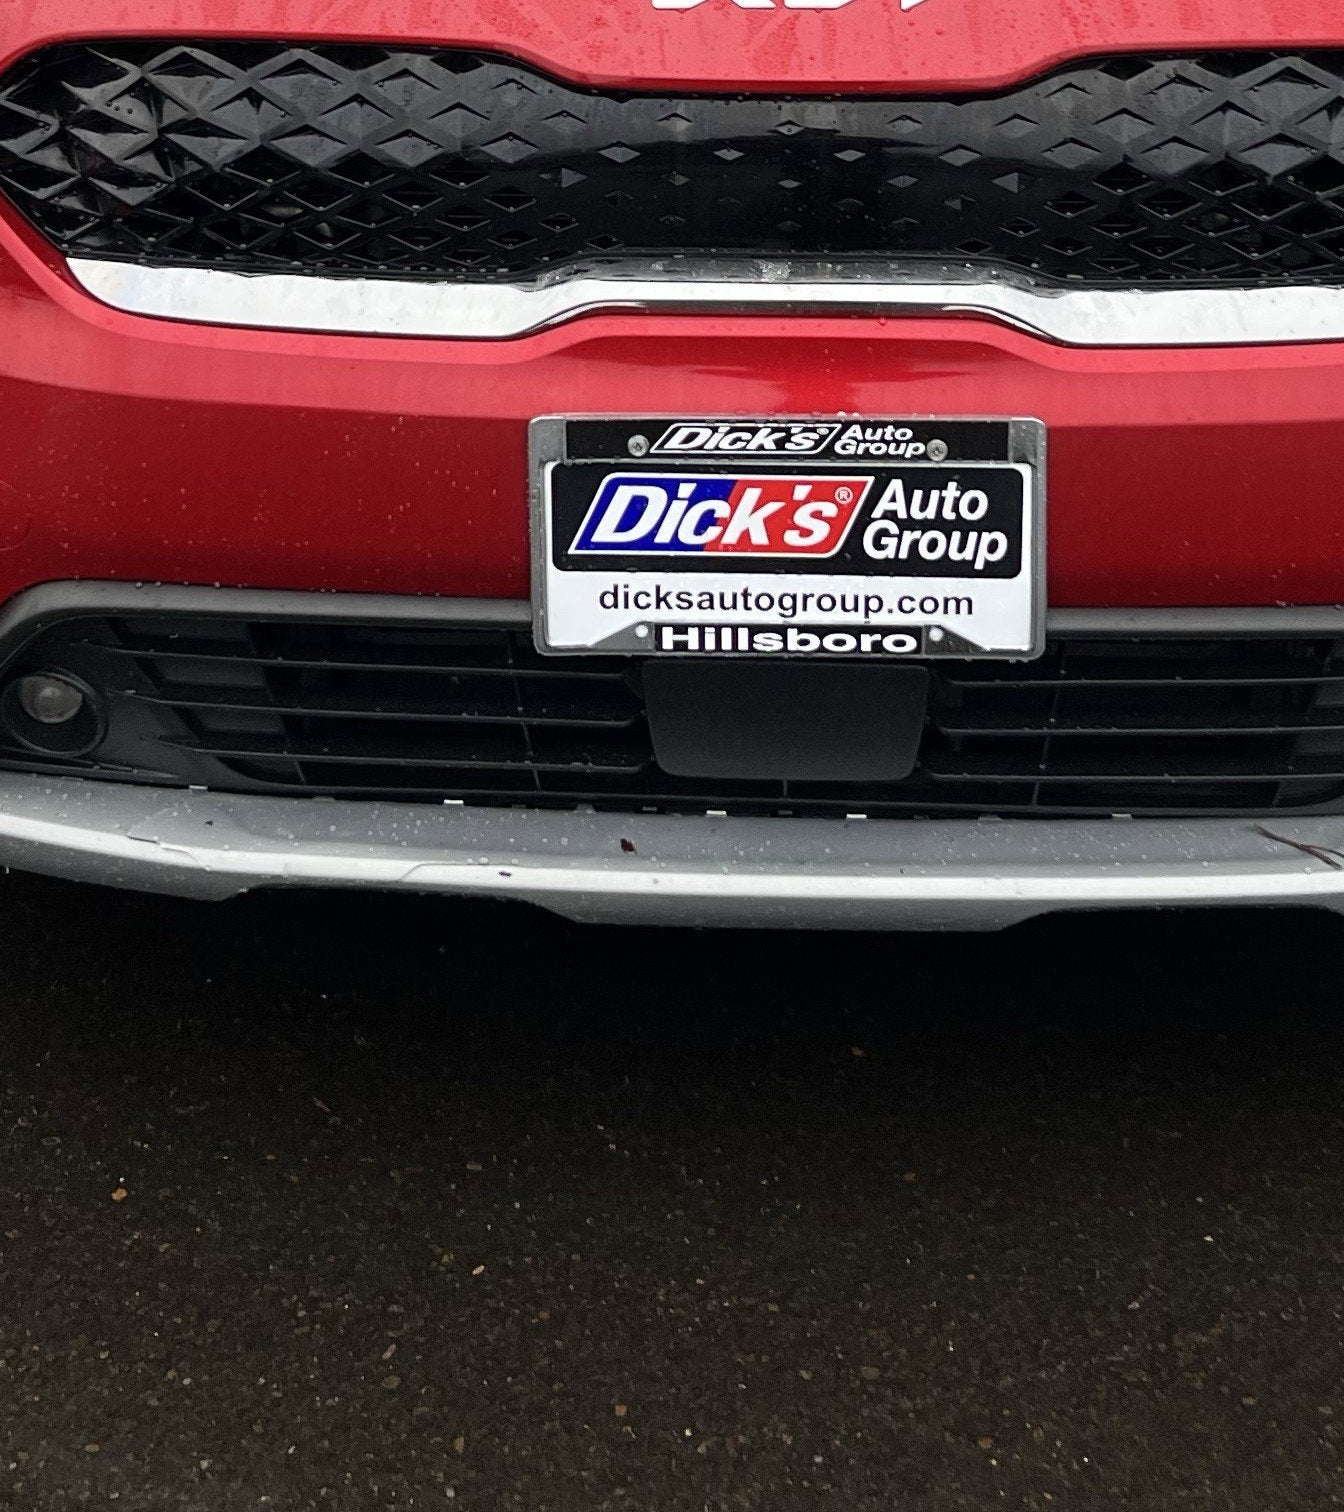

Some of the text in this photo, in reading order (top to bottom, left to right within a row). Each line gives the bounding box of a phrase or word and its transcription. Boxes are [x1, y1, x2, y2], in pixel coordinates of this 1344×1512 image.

[834, 439, 926, 458] Group
[840, 425, 913, 441] Auto
[871, 478, 988, 520] Auto
[862, 519, 1008, 570] Group
[599, 583, 974, 618] dicksautogroup.com
[662, 626, 918, 653] Hillsboro
